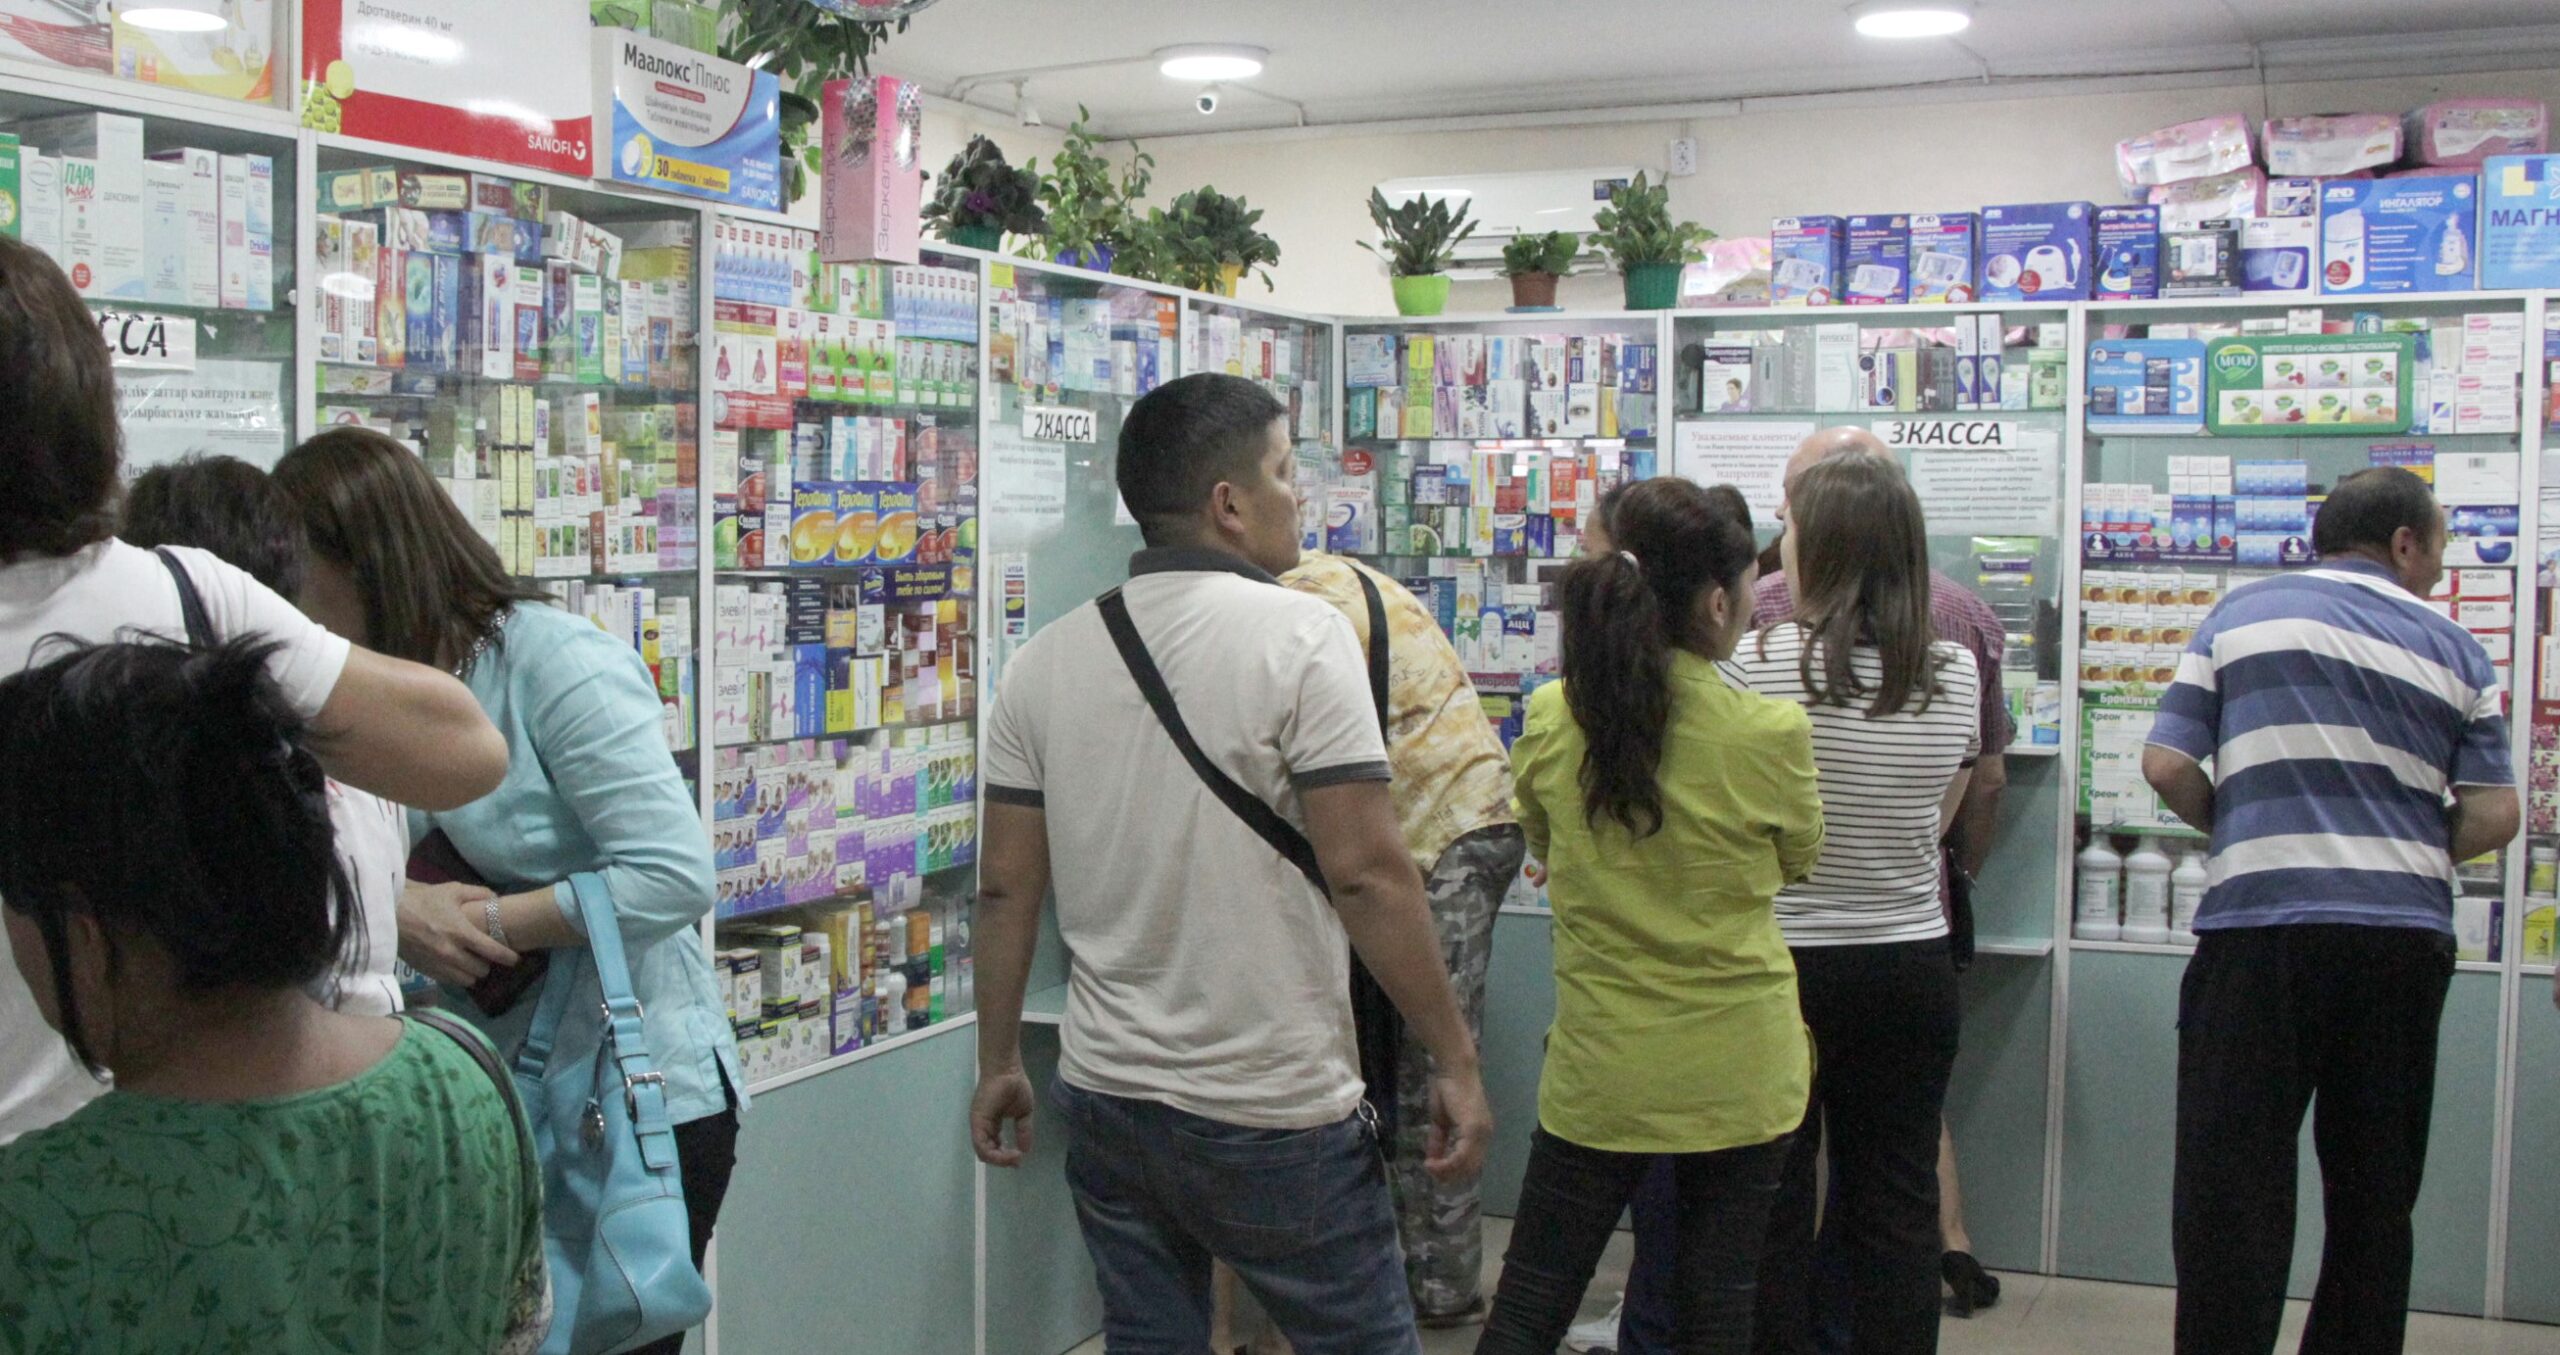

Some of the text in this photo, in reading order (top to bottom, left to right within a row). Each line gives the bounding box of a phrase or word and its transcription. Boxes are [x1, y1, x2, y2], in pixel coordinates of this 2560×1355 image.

[357, 1, 422, 27] Дротаверин
[424, 15, 437, 27] 40
[624, 43, 690, 83] Маалокс
[695, 63, 731, 94] Плюс
[528, 134, 571, 155] SANOFI
[64, 162, 95, 187] ПАРА
[656, 158, 669, 177] 30
[741, 184, 769, 201] SANOFI
[822, 133, 837, 255] Зеркалин
[877, 128, 891, 252] Зеркалин
[2380, 196, 2443, 208] ИНГАЛЯТОР
[1034, 414, 1091, 441] 2КАССА
[1888, 421, 2003, 445] 3КАССА
[1007, 565, 1024, 574] VISA
[2462, 572, 2495, 580] НО-ШПА
[2461, 604, 2495, 612] НО-ШПА
[1507, 619, 1530, 630] АЦЦ
[2089, 711, 2121, 721] Креон
[2088, 750, 2120, 760] Креон
[2088, 788, 2119, 798] Креон
[2157, 813, 2183, 824] Крео
